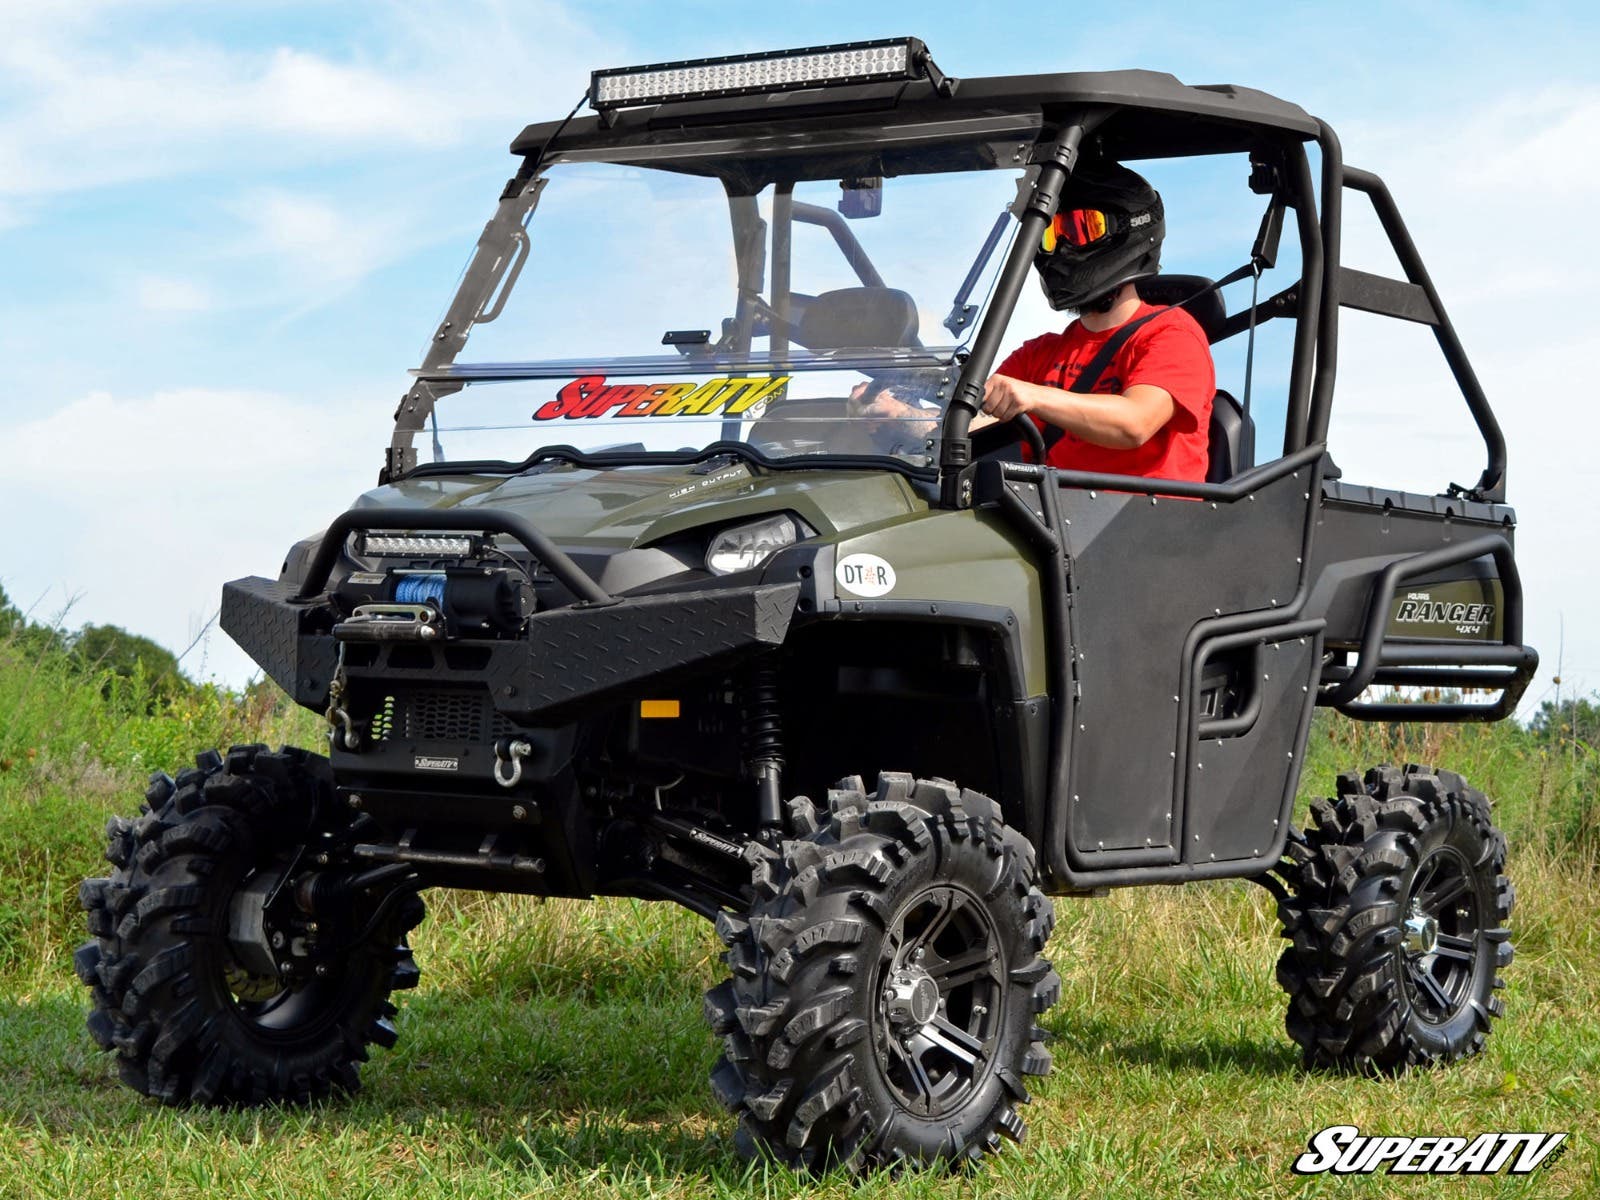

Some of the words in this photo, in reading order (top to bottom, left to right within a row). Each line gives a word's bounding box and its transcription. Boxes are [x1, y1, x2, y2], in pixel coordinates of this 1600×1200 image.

[532, 375, 793, 420] SUPERATV
[701, 469, 742, 487] OUTPUT
[1396, 601, 1495, 625] RANGER
